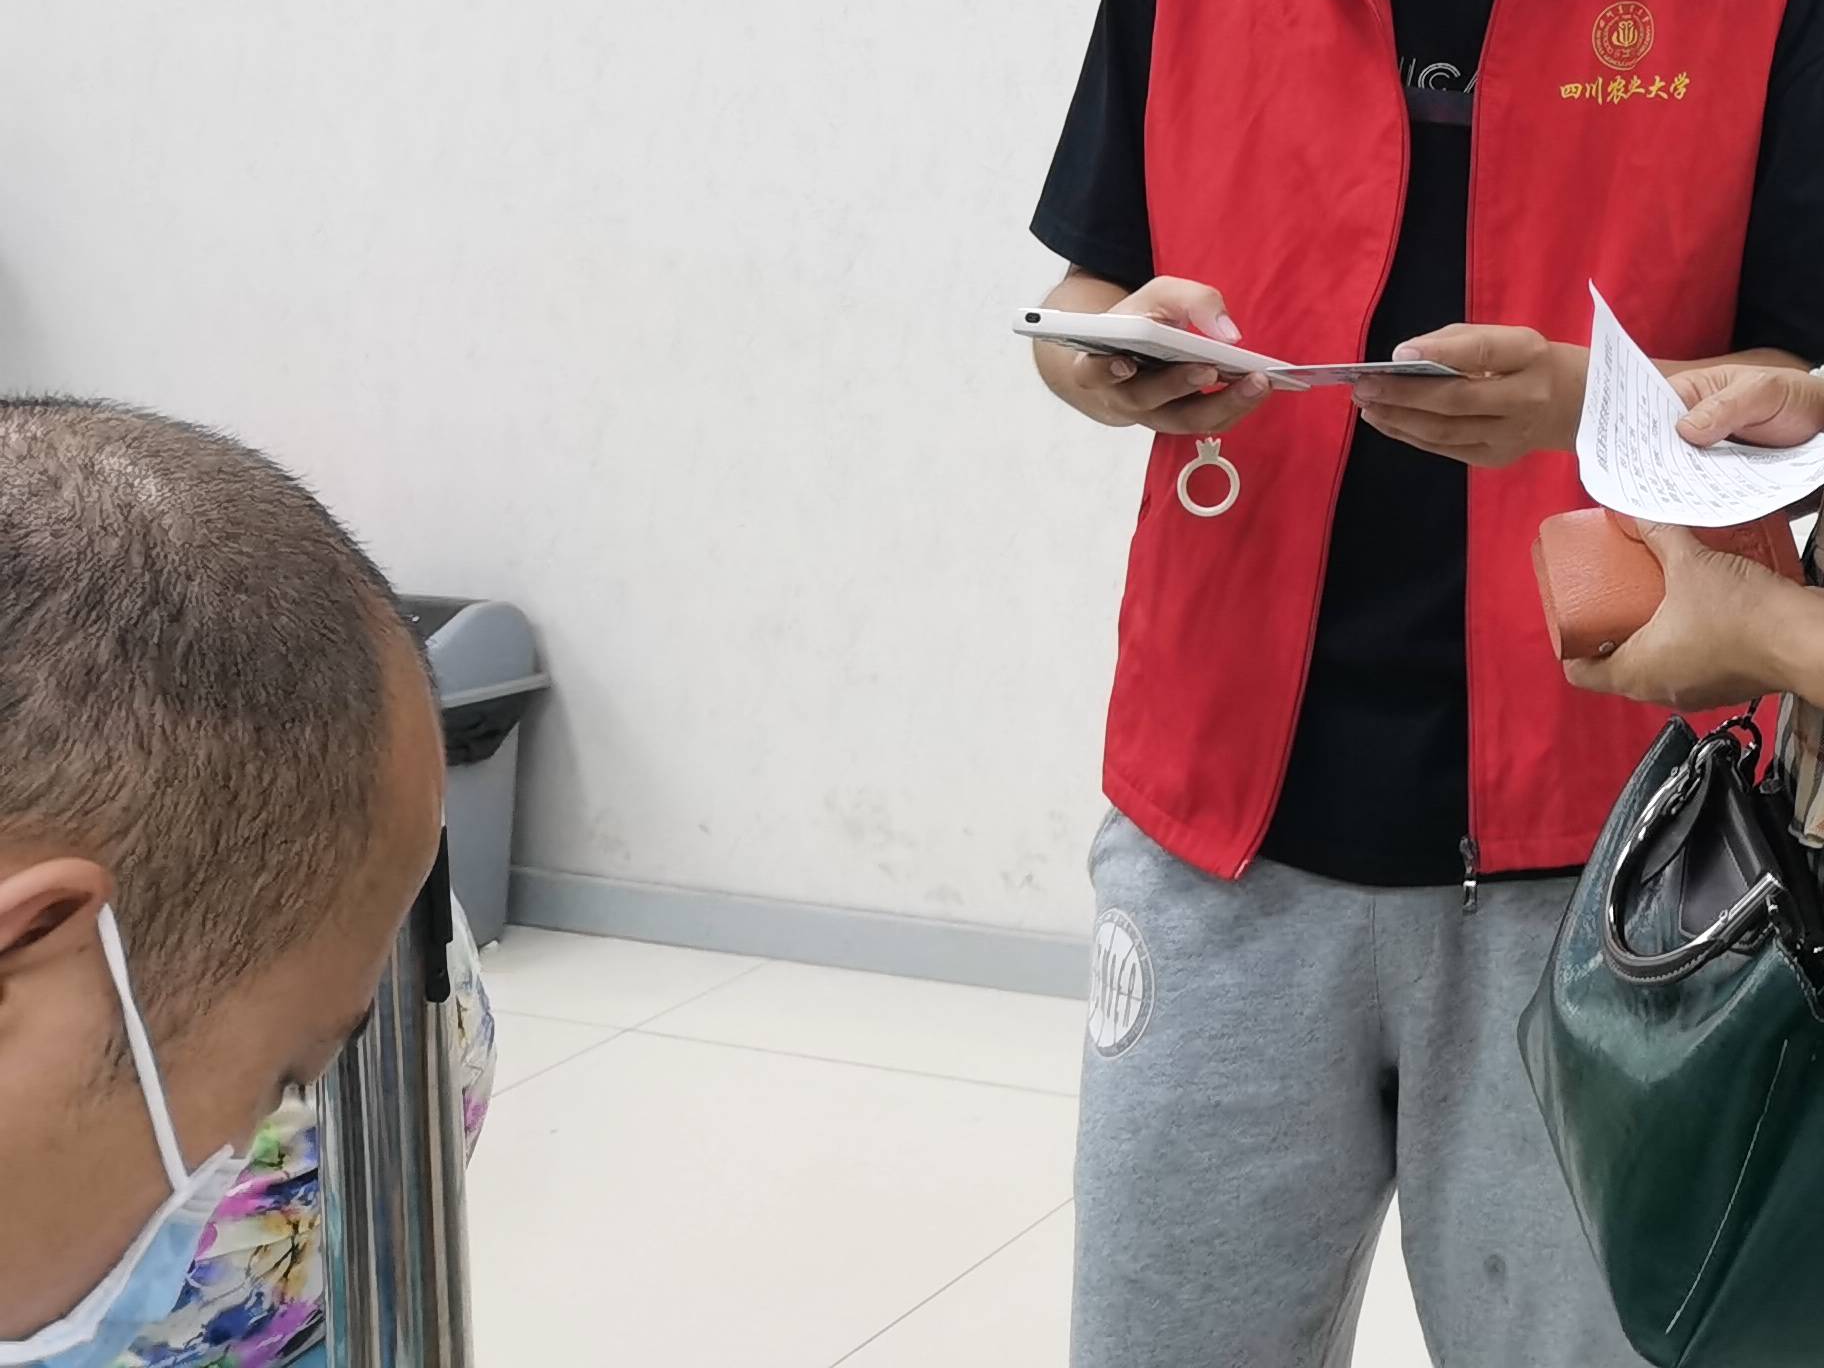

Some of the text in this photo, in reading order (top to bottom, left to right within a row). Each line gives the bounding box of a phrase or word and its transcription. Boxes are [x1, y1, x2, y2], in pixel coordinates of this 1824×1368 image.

[1560, 71, 1690, 105] 四川农业大学
